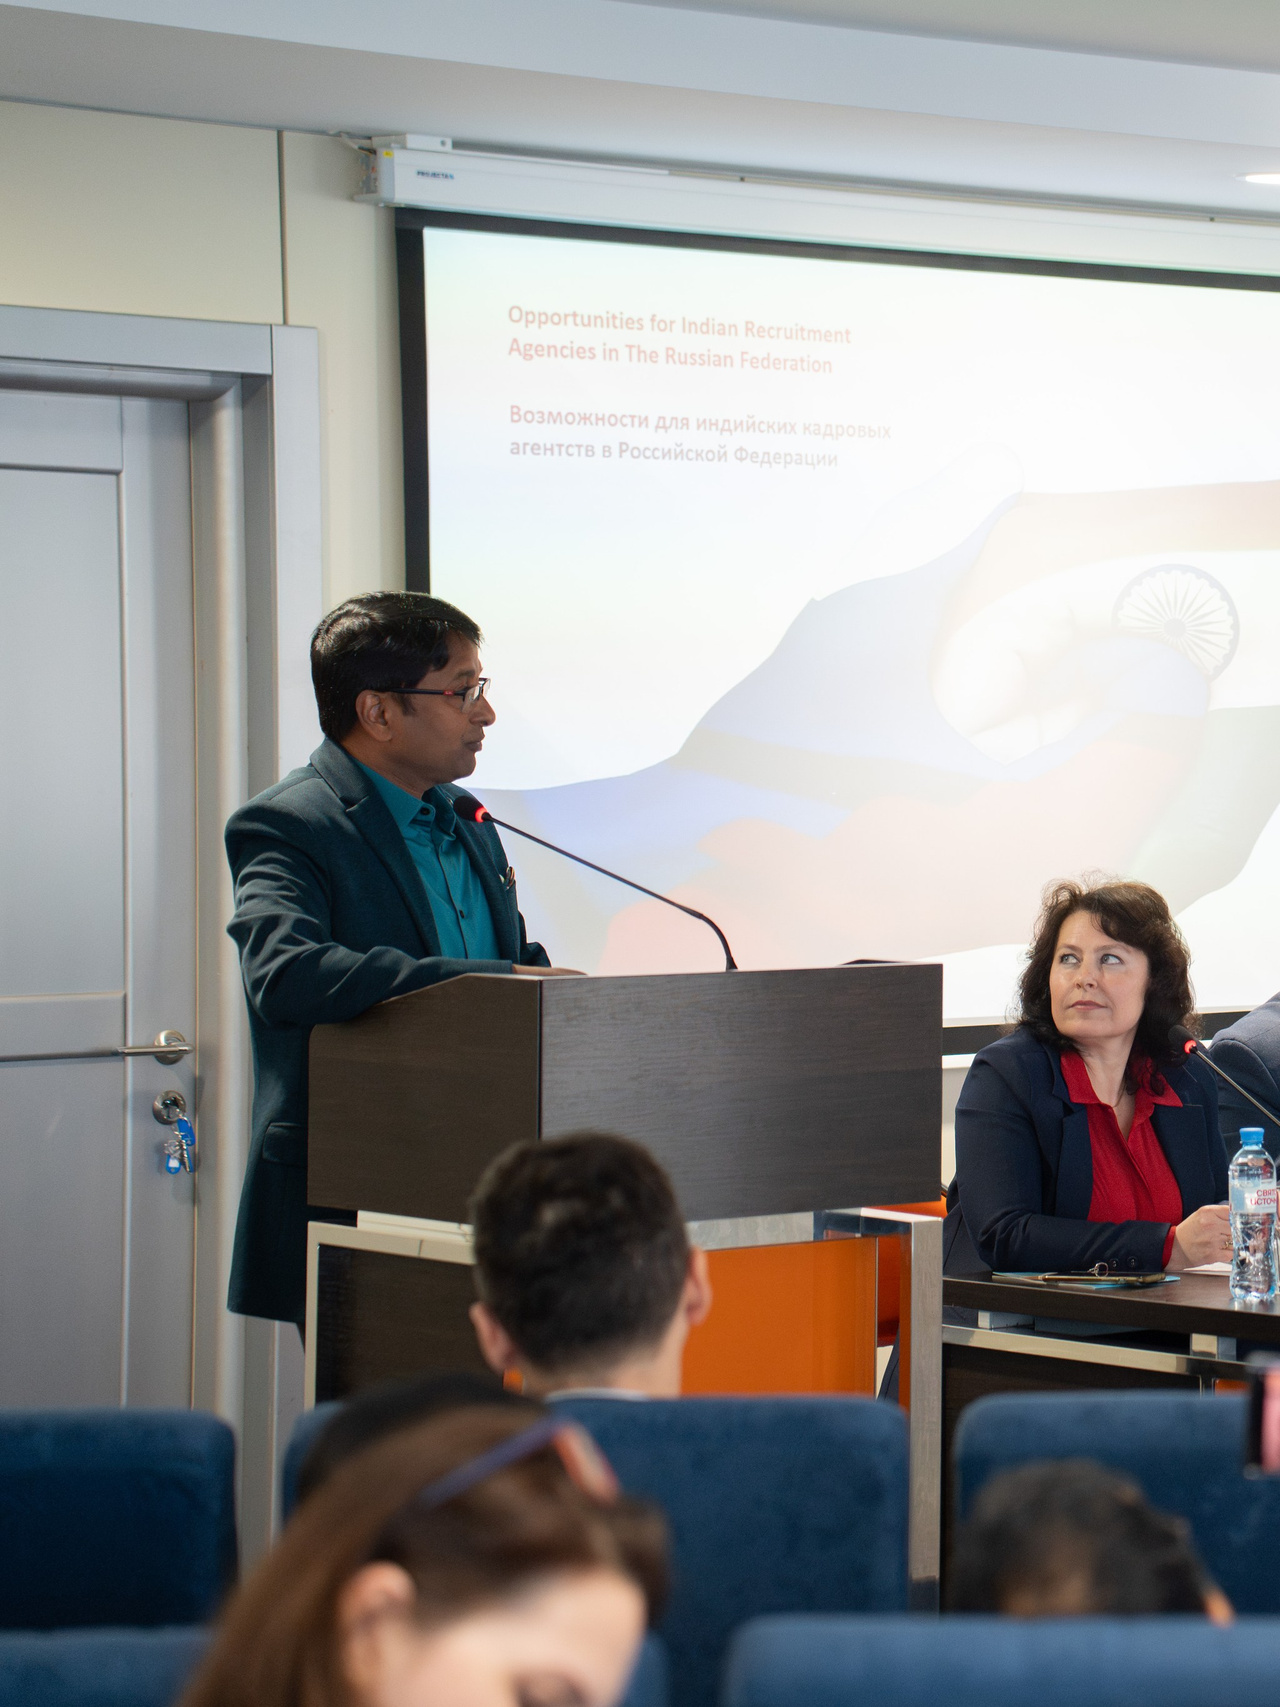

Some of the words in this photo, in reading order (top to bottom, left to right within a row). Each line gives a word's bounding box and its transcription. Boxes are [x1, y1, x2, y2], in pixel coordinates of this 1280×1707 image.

[508, 305, 644, 331] Opportunities
[650, 314, 676, 332] for
[682, 317, 738, 336] Indian
[745, 320, 851, 344] Recruitment
[508, 338, 596, 361] Agencies
[603, 343, 619, 361] in
[625, 344, 659, 364] The
[665, 347, 734, 367] Russian
[741, 351, 832, 373] Federation
[510, 405, 649, 428] Возможности
[655, 416, 689, 433] для
[697, 415, 796, 435] индийских
[803, 423, 890, 440] кадровых
[510, 442, 595, 457] агентств
[602, 445, 612, 458] в
[619, 442, 727, 462] Российской
[734, 446, 837, 469] Федерации
